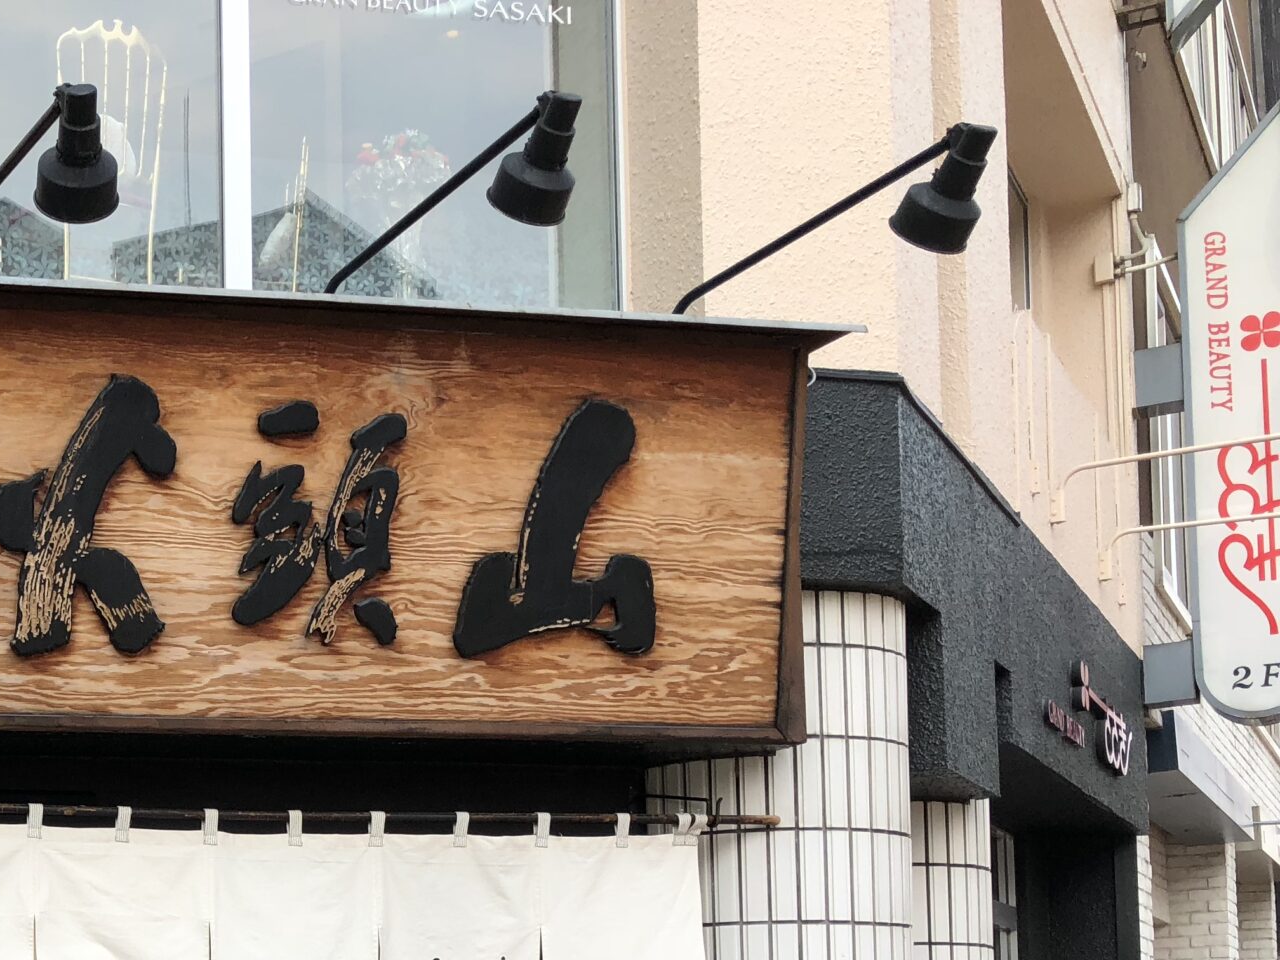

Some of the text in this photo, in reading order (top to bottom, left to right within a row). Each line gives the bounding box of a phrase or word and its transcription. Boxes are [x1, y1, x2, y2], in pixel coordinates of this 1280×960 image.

[473, 0, 572, 25] SASAKI
[1204, 231, 1233, 412] GRAND BEAUTY
